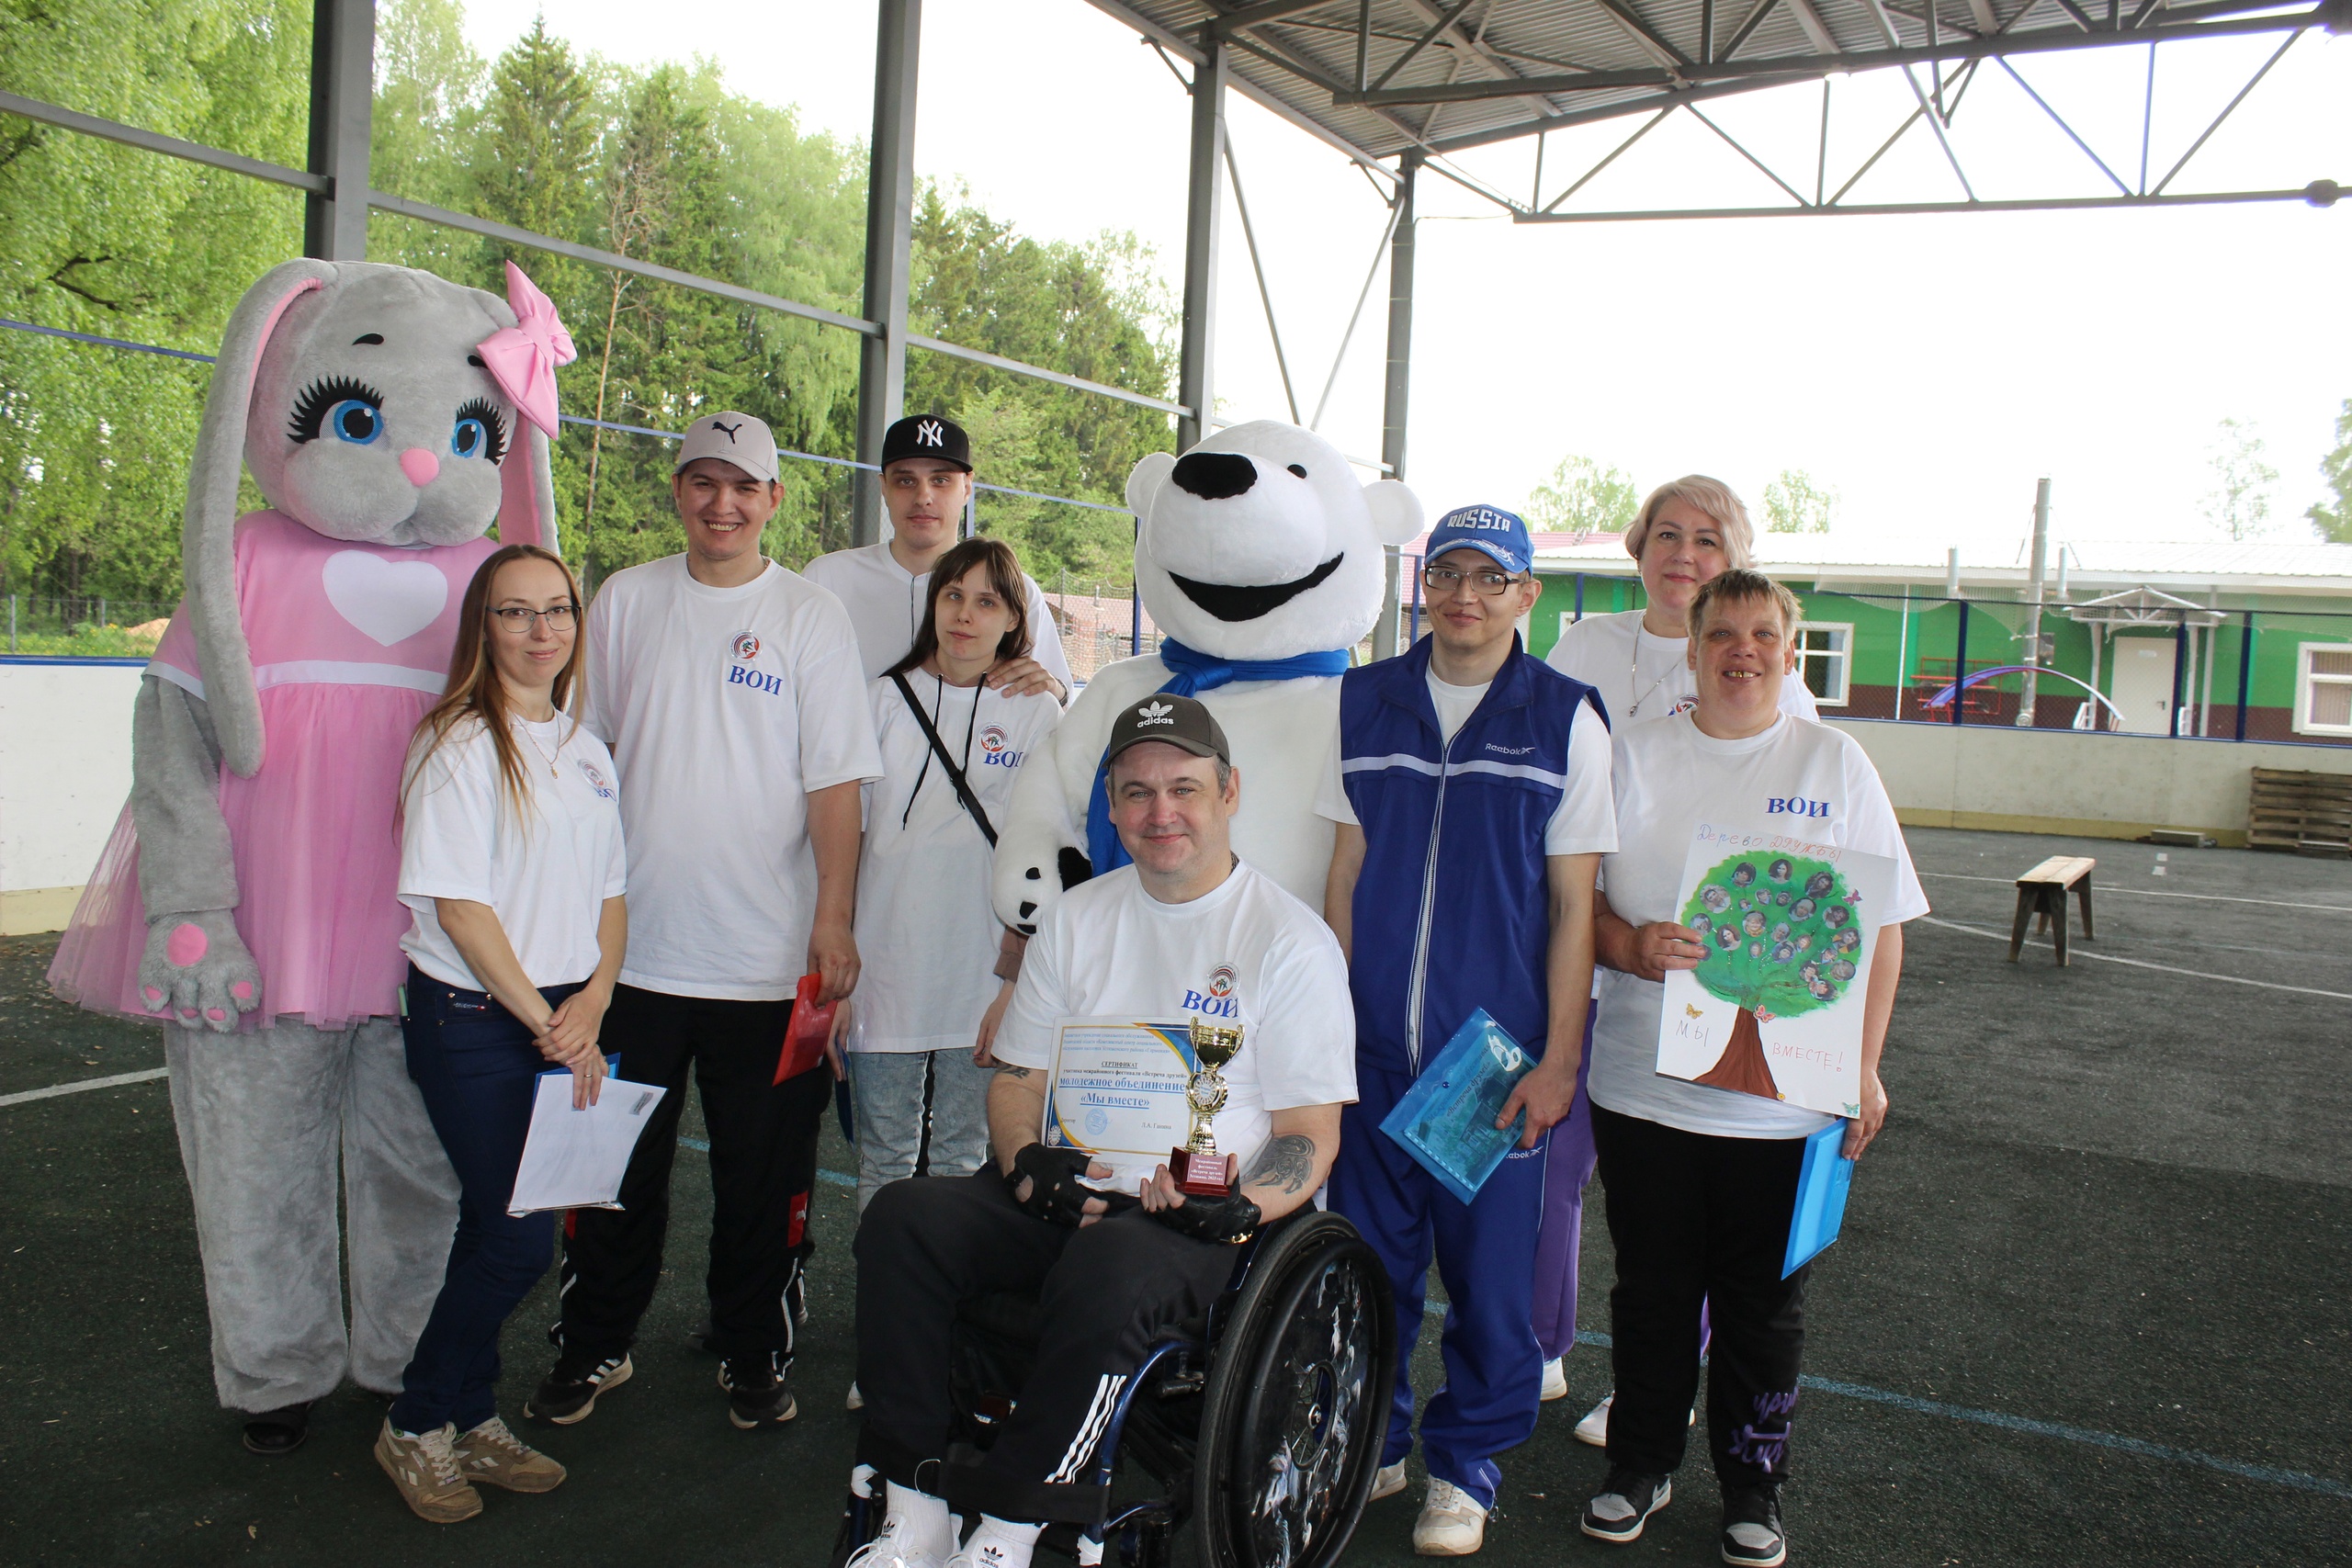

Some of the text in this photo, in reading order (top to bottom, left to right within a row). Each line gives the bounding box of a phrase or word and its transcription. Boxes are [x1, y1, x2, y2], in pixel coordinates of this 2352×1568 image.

[916, 419, 944, 447] NY
[1447, 508, 1511, 533] RUSSIA
[728, 664, 784, 696] ВОИ
[1137, 716, 1174, 728] adidas
[1485, 742, 1521, 756] Reebok
[1765, 795, 1830, 818] ВОИ
[1697, 823, 1763, 847] Дерево
[1181, 988, 1238, 1018] ВОИ
[1772, 1042, 1844, 1073] ВМЕСТЕ!
[1059, 1077, 1113, 1088] молодежное
[1114, 1077, 1185, 1091] объединение
[1080, 1092, 1150, 1107] «Мы вместе»
